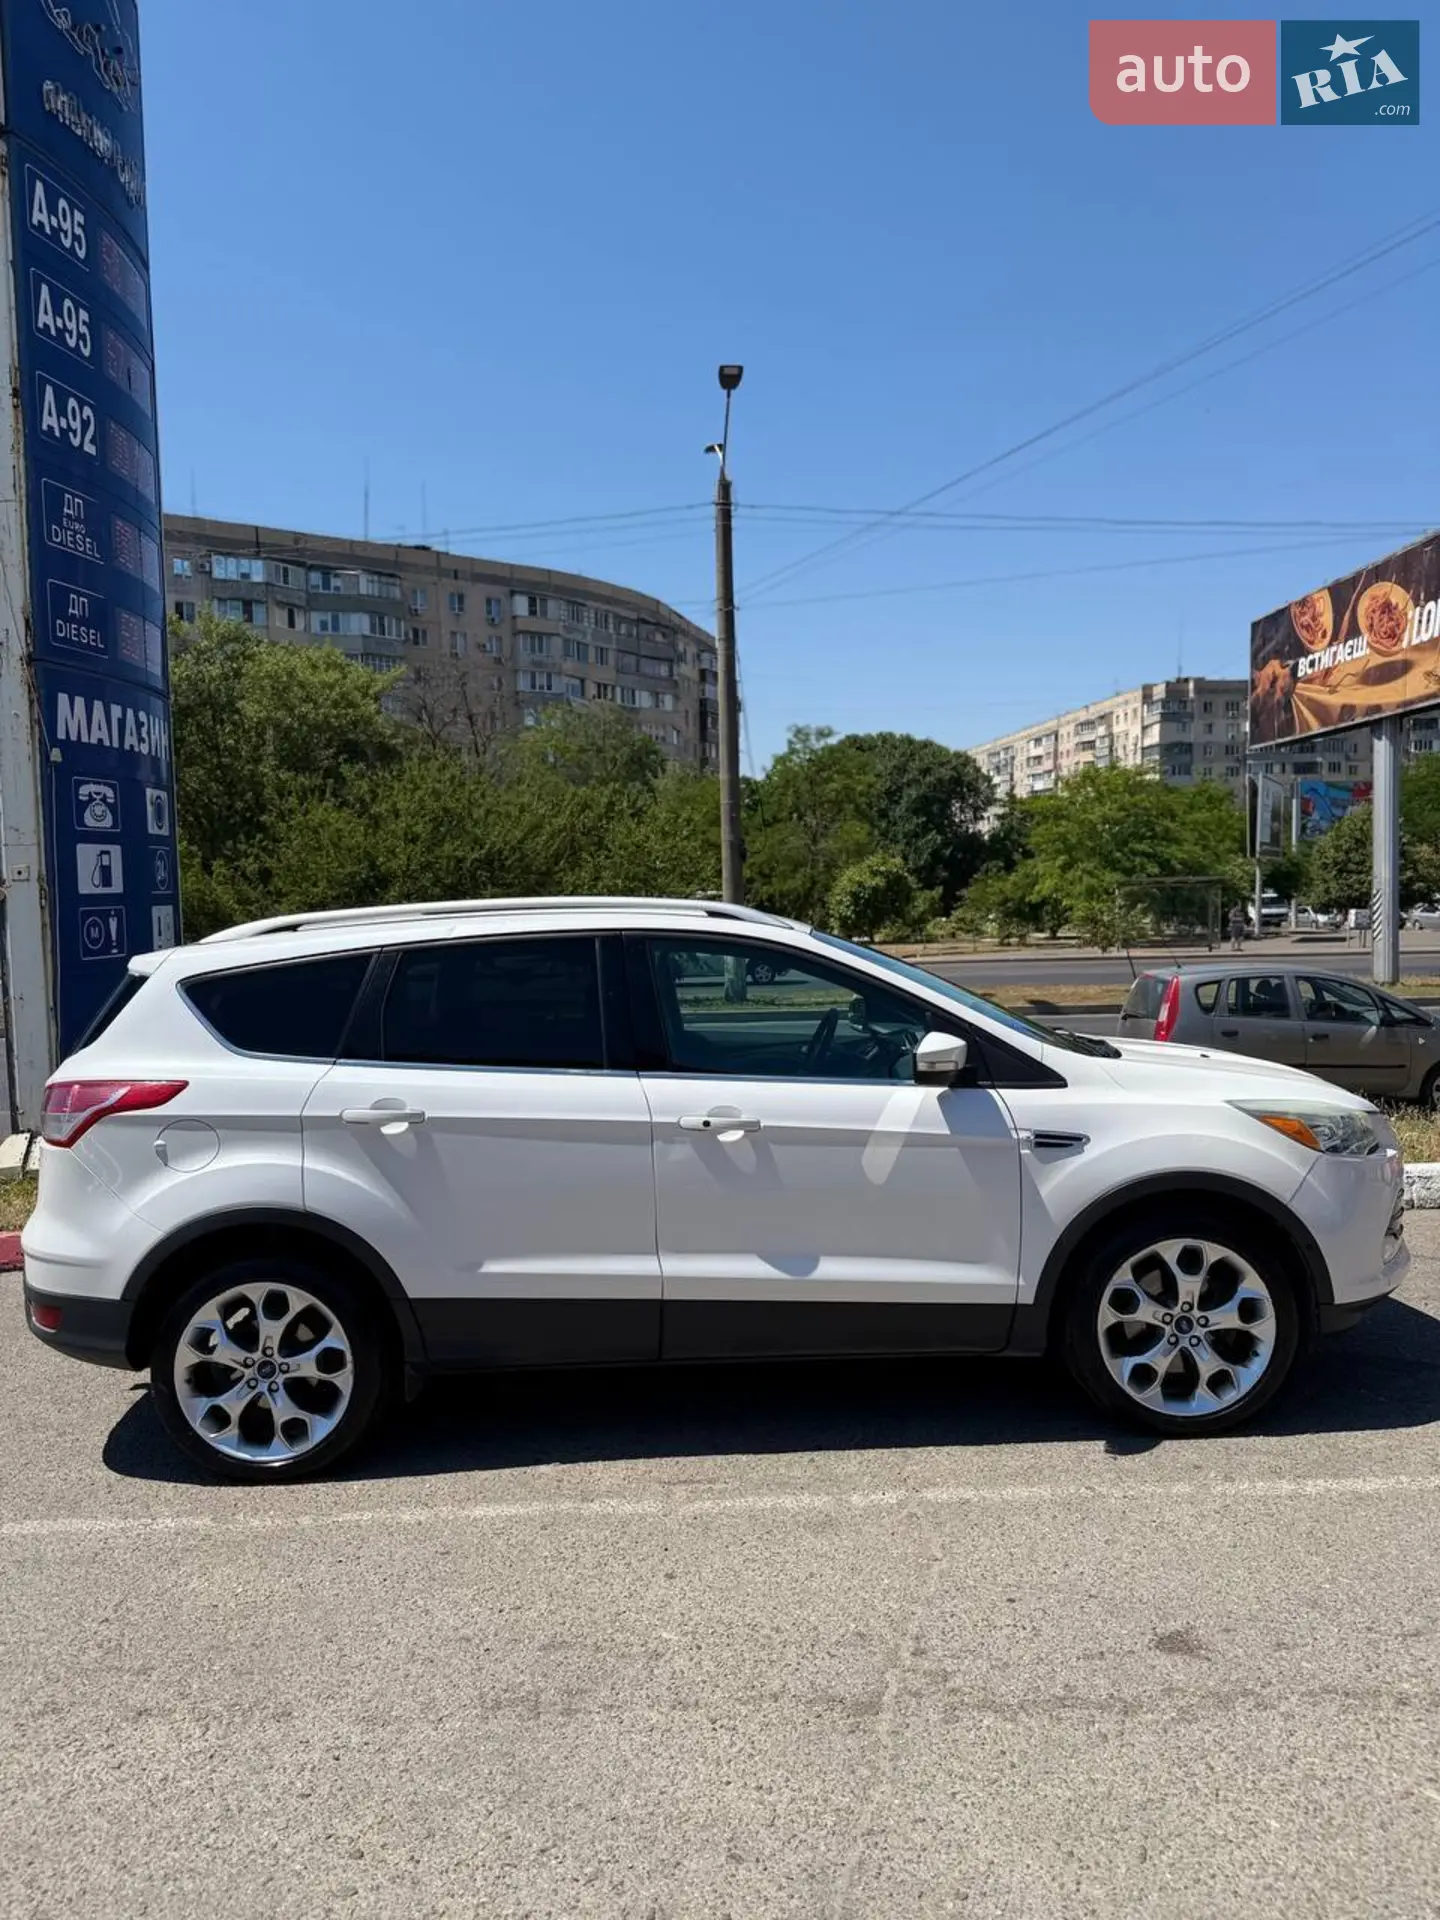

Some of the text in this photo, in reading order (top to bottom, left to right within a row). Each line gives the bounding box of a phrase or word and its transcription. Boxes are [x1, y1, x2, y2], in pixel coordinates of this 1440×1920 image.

[63, 493, 84, 519] ДП
[63, 518, 86, 533] EURO
[52, 525, 101, 558] DIESEL
[68, 593, 88, 619] ДП
[56, 619, 104, 648] DIESEL
[56, 692, 169, 761] МАГАЗИН
